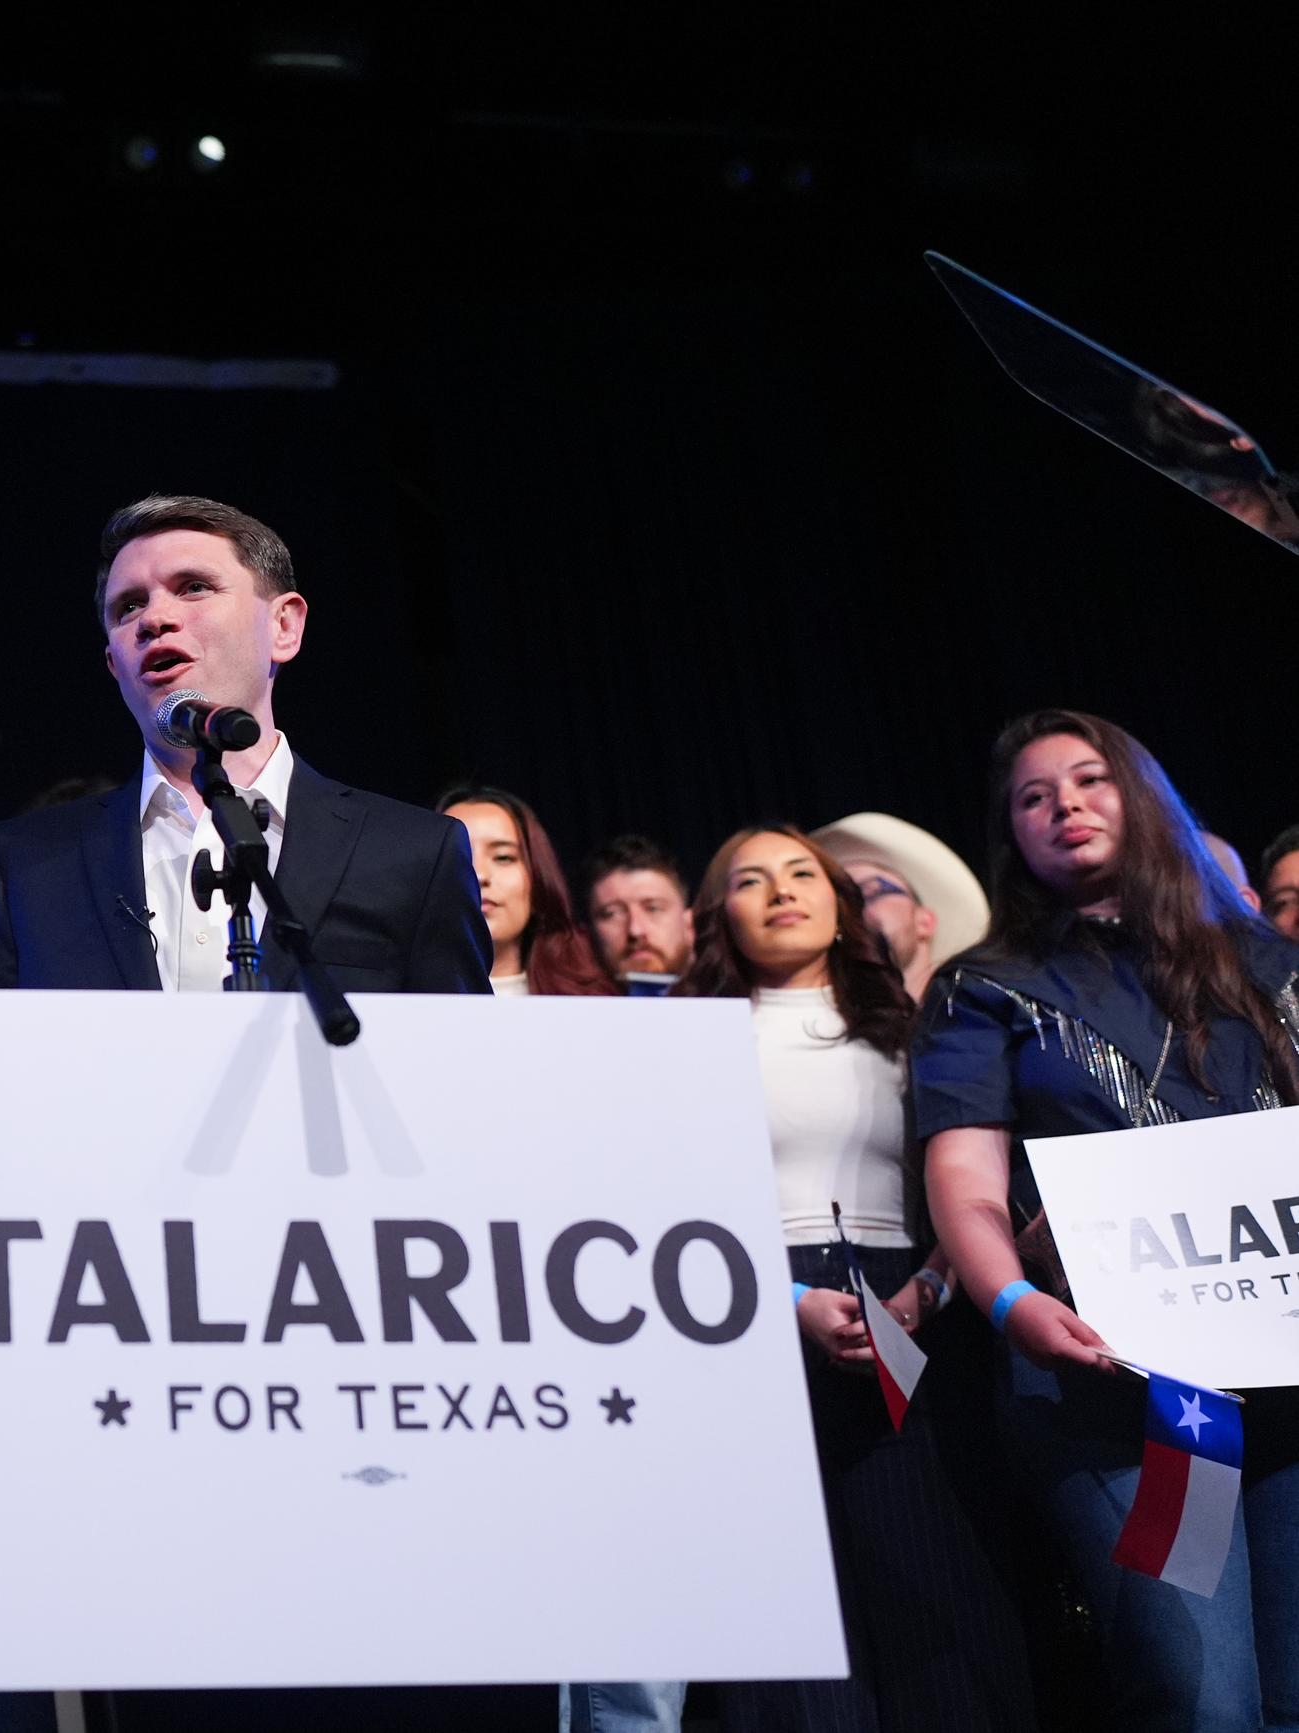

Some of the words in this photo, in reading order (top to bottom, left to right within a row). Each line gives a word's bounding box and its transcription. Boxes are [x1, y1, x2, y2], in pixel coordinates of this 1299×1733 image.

[1191, 1278, 1259, 1305] FOR
[168, 1385, 303, 1432] FOR
[338, 1384, 570, 1431] TEXAS
